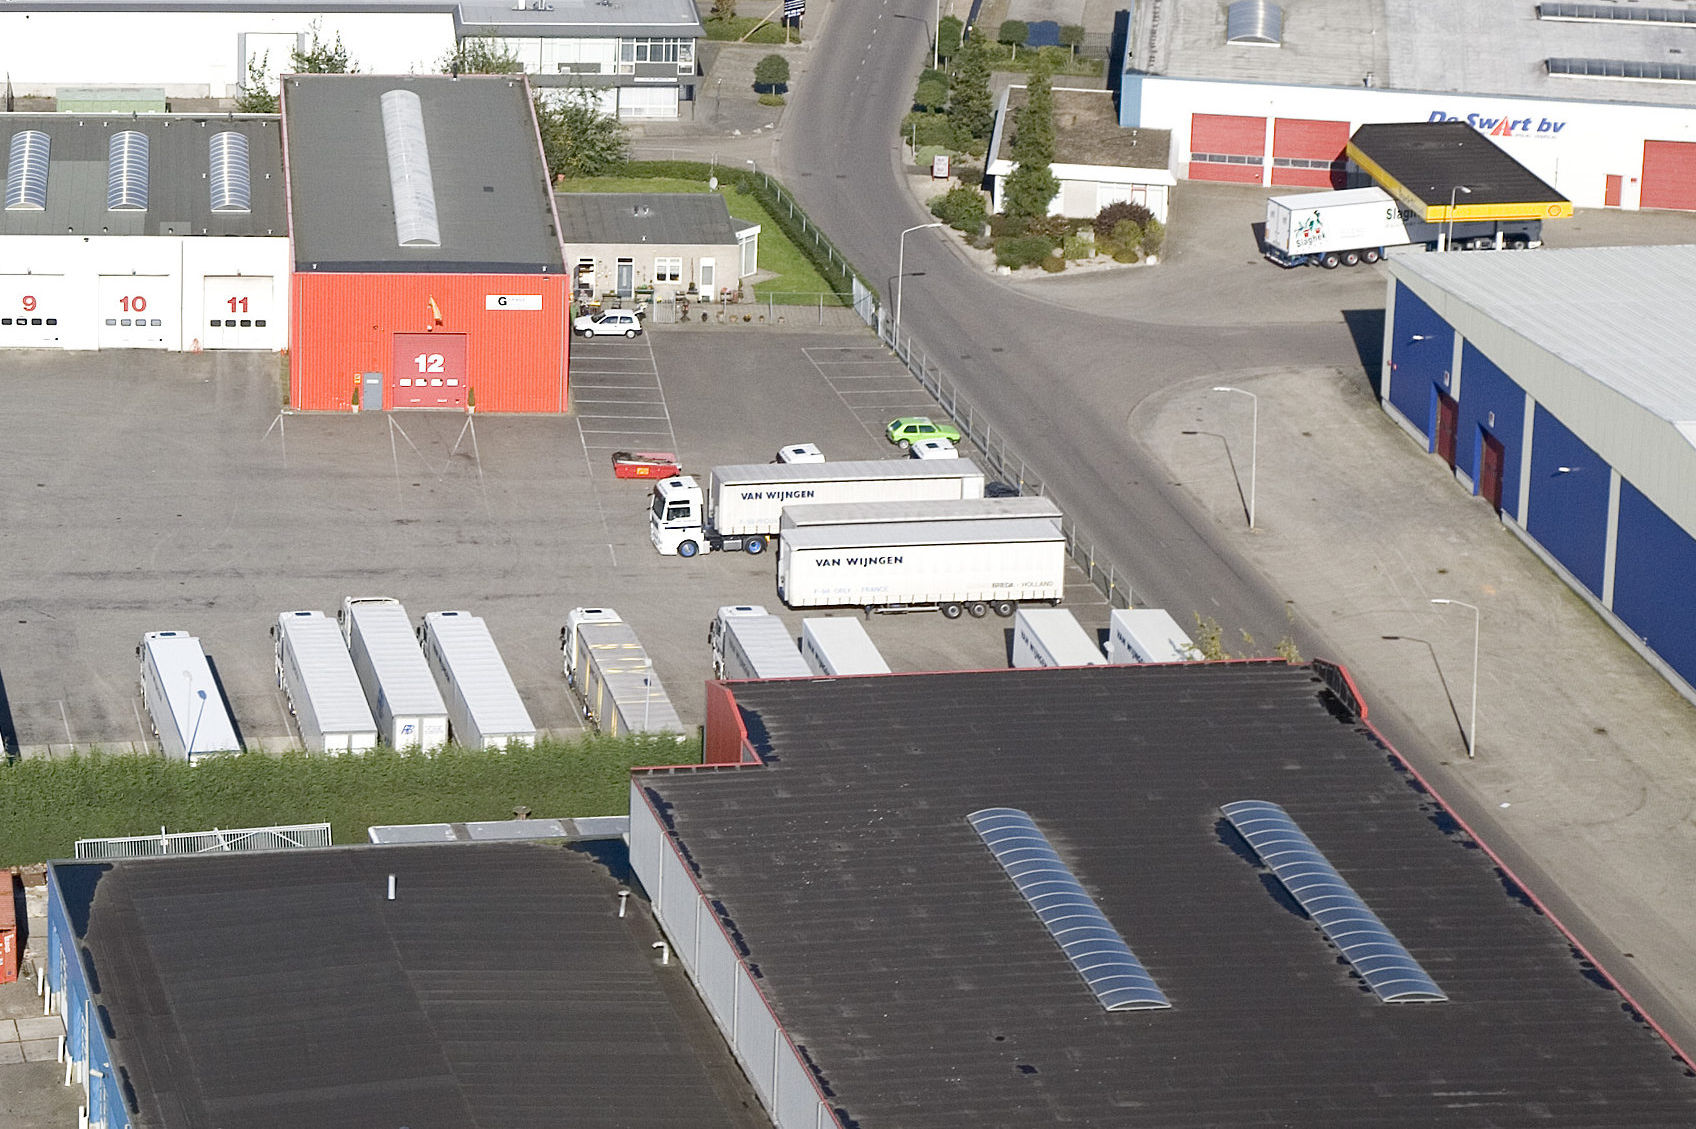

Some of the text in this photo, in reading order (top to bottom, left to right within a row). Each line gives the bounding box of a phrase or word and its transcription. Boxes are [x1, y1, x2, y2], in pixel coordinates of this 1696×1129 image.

[1537, 117, 1566, 133] bv
[1296, 232, 1326, 248] Slaghek
[22, 294, 37, 311] 9
[120, 295, 147, 312] 10
[227, 296, 249, 312] 11
[414, 352, 446, 374] 12
[741, 490, 815, 503] VAN WIJNGEN
[816, 556, 904, 568] VAN WIJNGEN
